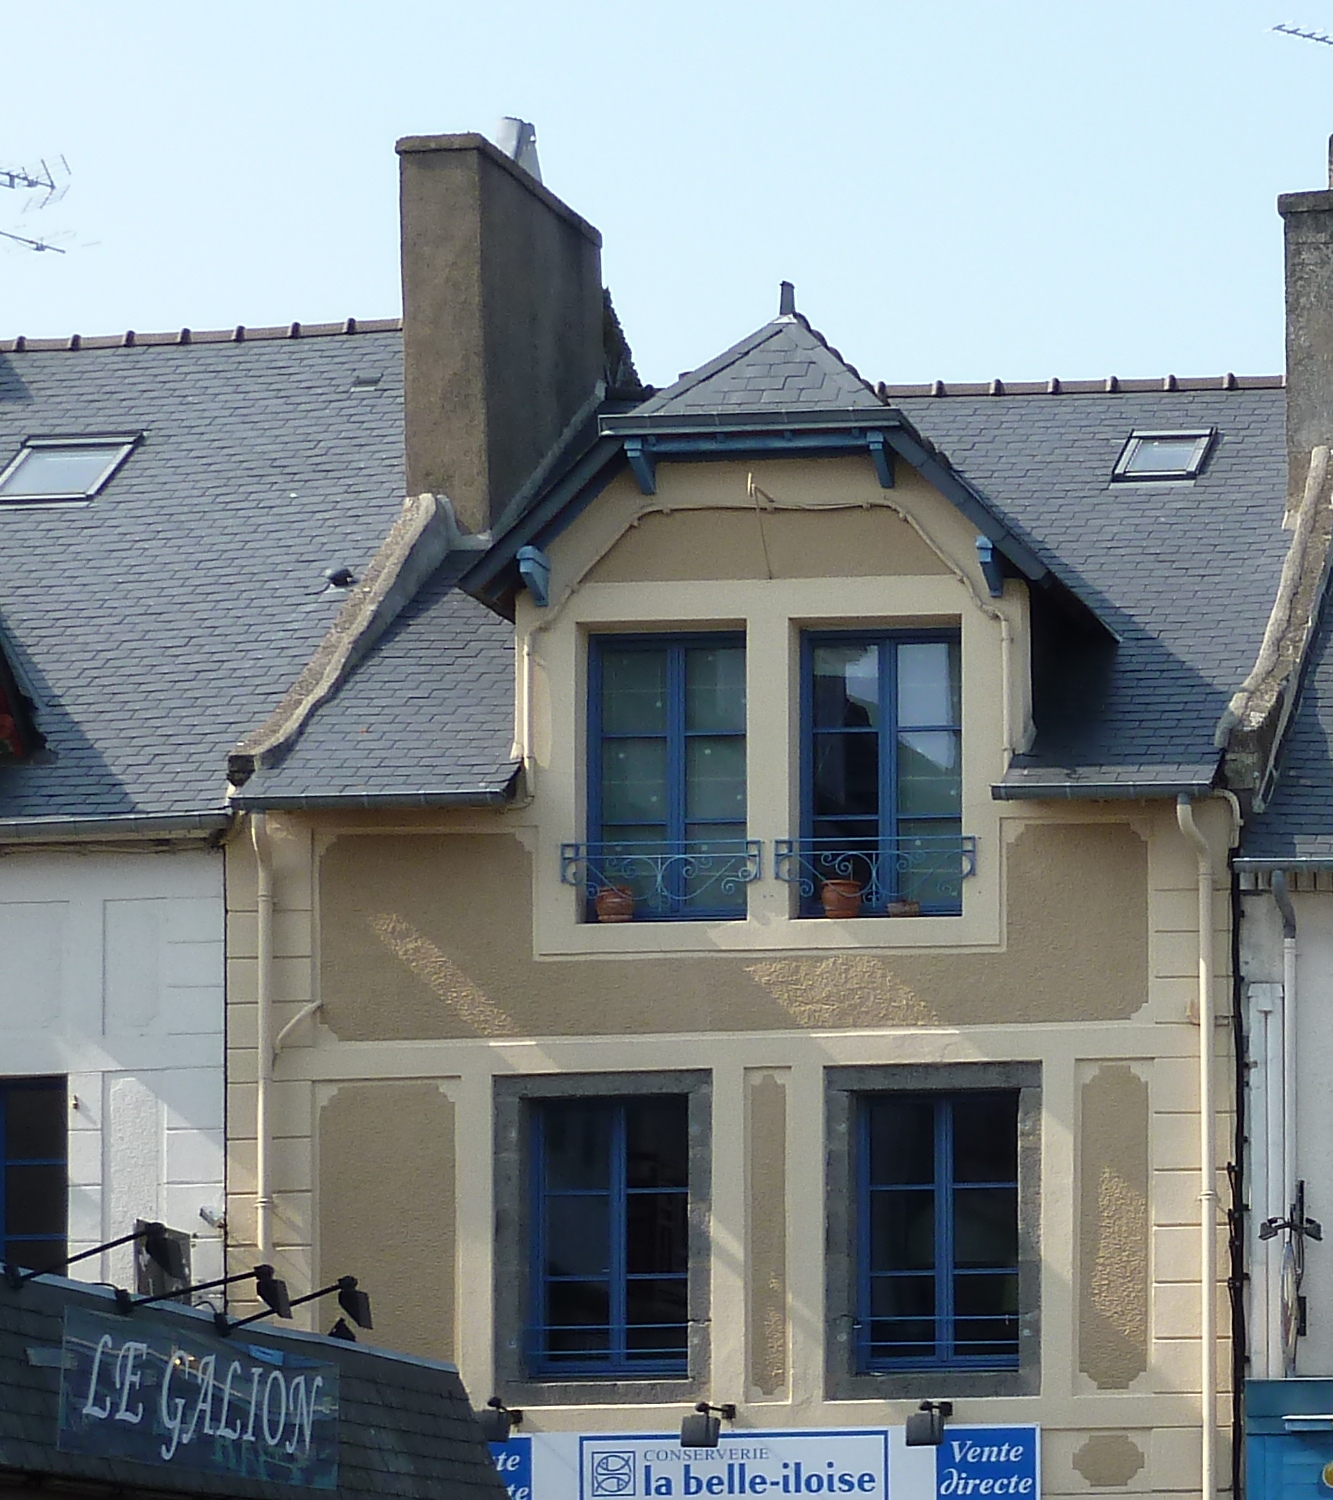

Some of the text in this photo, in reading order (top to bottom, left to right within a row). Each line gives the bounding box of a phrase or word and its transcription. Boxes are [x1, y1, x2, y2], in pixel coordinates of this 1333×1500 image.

[82, 1334, 148, 1424] LE
[161, 1349, 323, 1460] GALION
[644, 1447, 770, 1462] CONSERVERIE
[950, 1440, 1024, 1464] Vente
[643, 1460, 877, 1496] la belle-iloise
[940, 1467, 1033, 1496] directe
